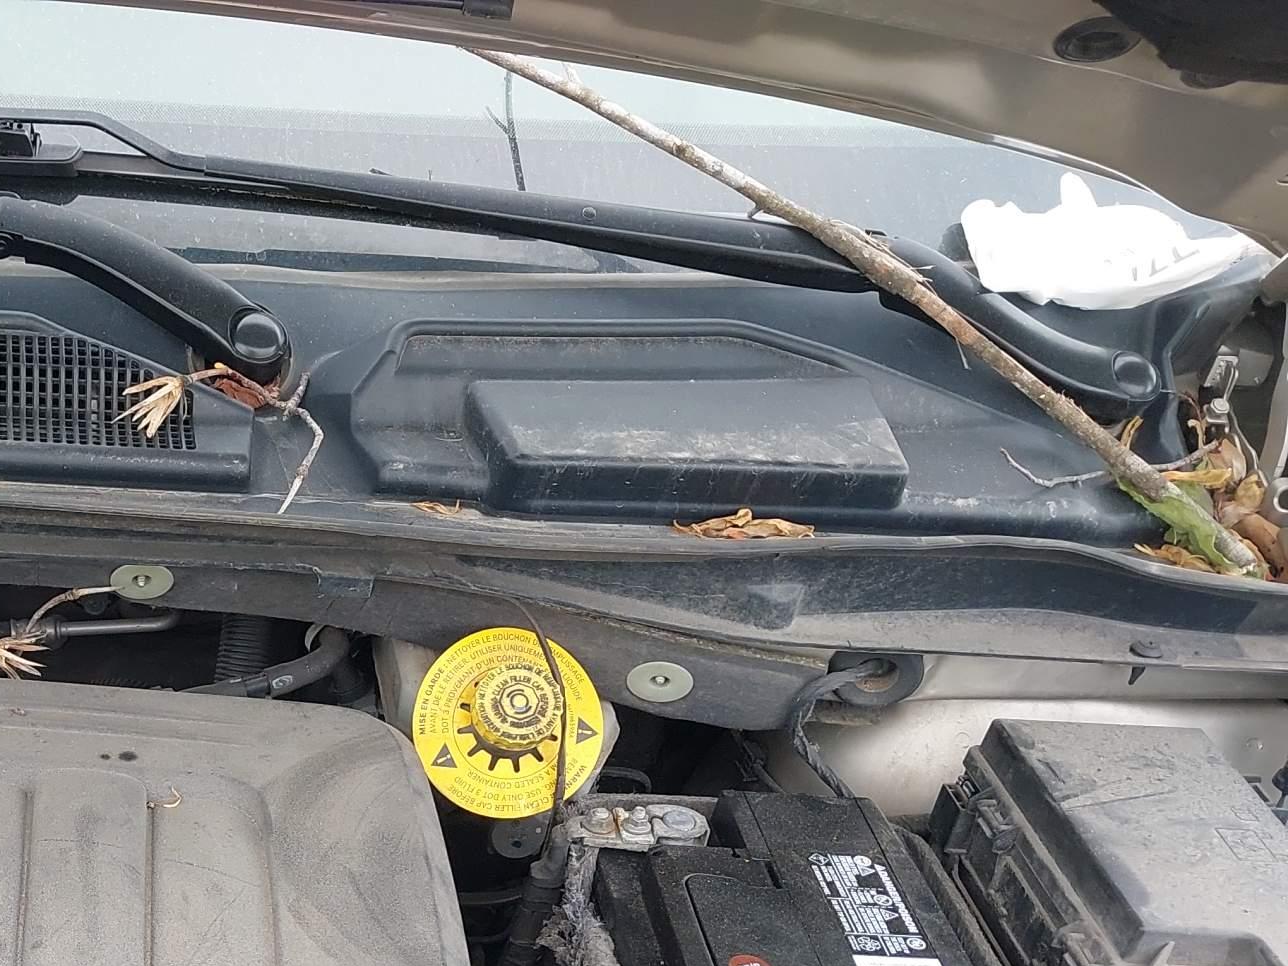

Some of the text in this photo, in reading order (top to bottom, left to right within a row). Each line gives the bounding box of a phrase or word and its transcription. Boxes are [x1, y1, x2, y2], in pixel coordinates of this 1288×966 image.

[481, 635, 491, 644] LE
[493, 632, 531, 643] BOUCHON
[447, 638, 480, 665] NETTOYER
[470, 643, 502, 660] UTILISER
[425, 667, 445, 696] GARDE
[439, 684, 447, 694] LE
[421, 698, 429, 711] EN
[432, 695, 441, 706] DE
[419, 713, 427, 735] MISE
[429, 708, 438, 734] AVANT
[441, 717, 450, 734] DOT
[454, 776, 475, 794] FLUID
[514, 772, 545, 789] SEALED
[448, 784, 475, 805] BEFORE
[483, 791, 500, 801] DOT
[502, 793, 524, 801] ONLY
[525, 788, 542, 799] USE
[476, 801, 493, 810] CAP
[494, 804, 522, 812] FILLER
[523, 796, 550, 810] CLEAN
